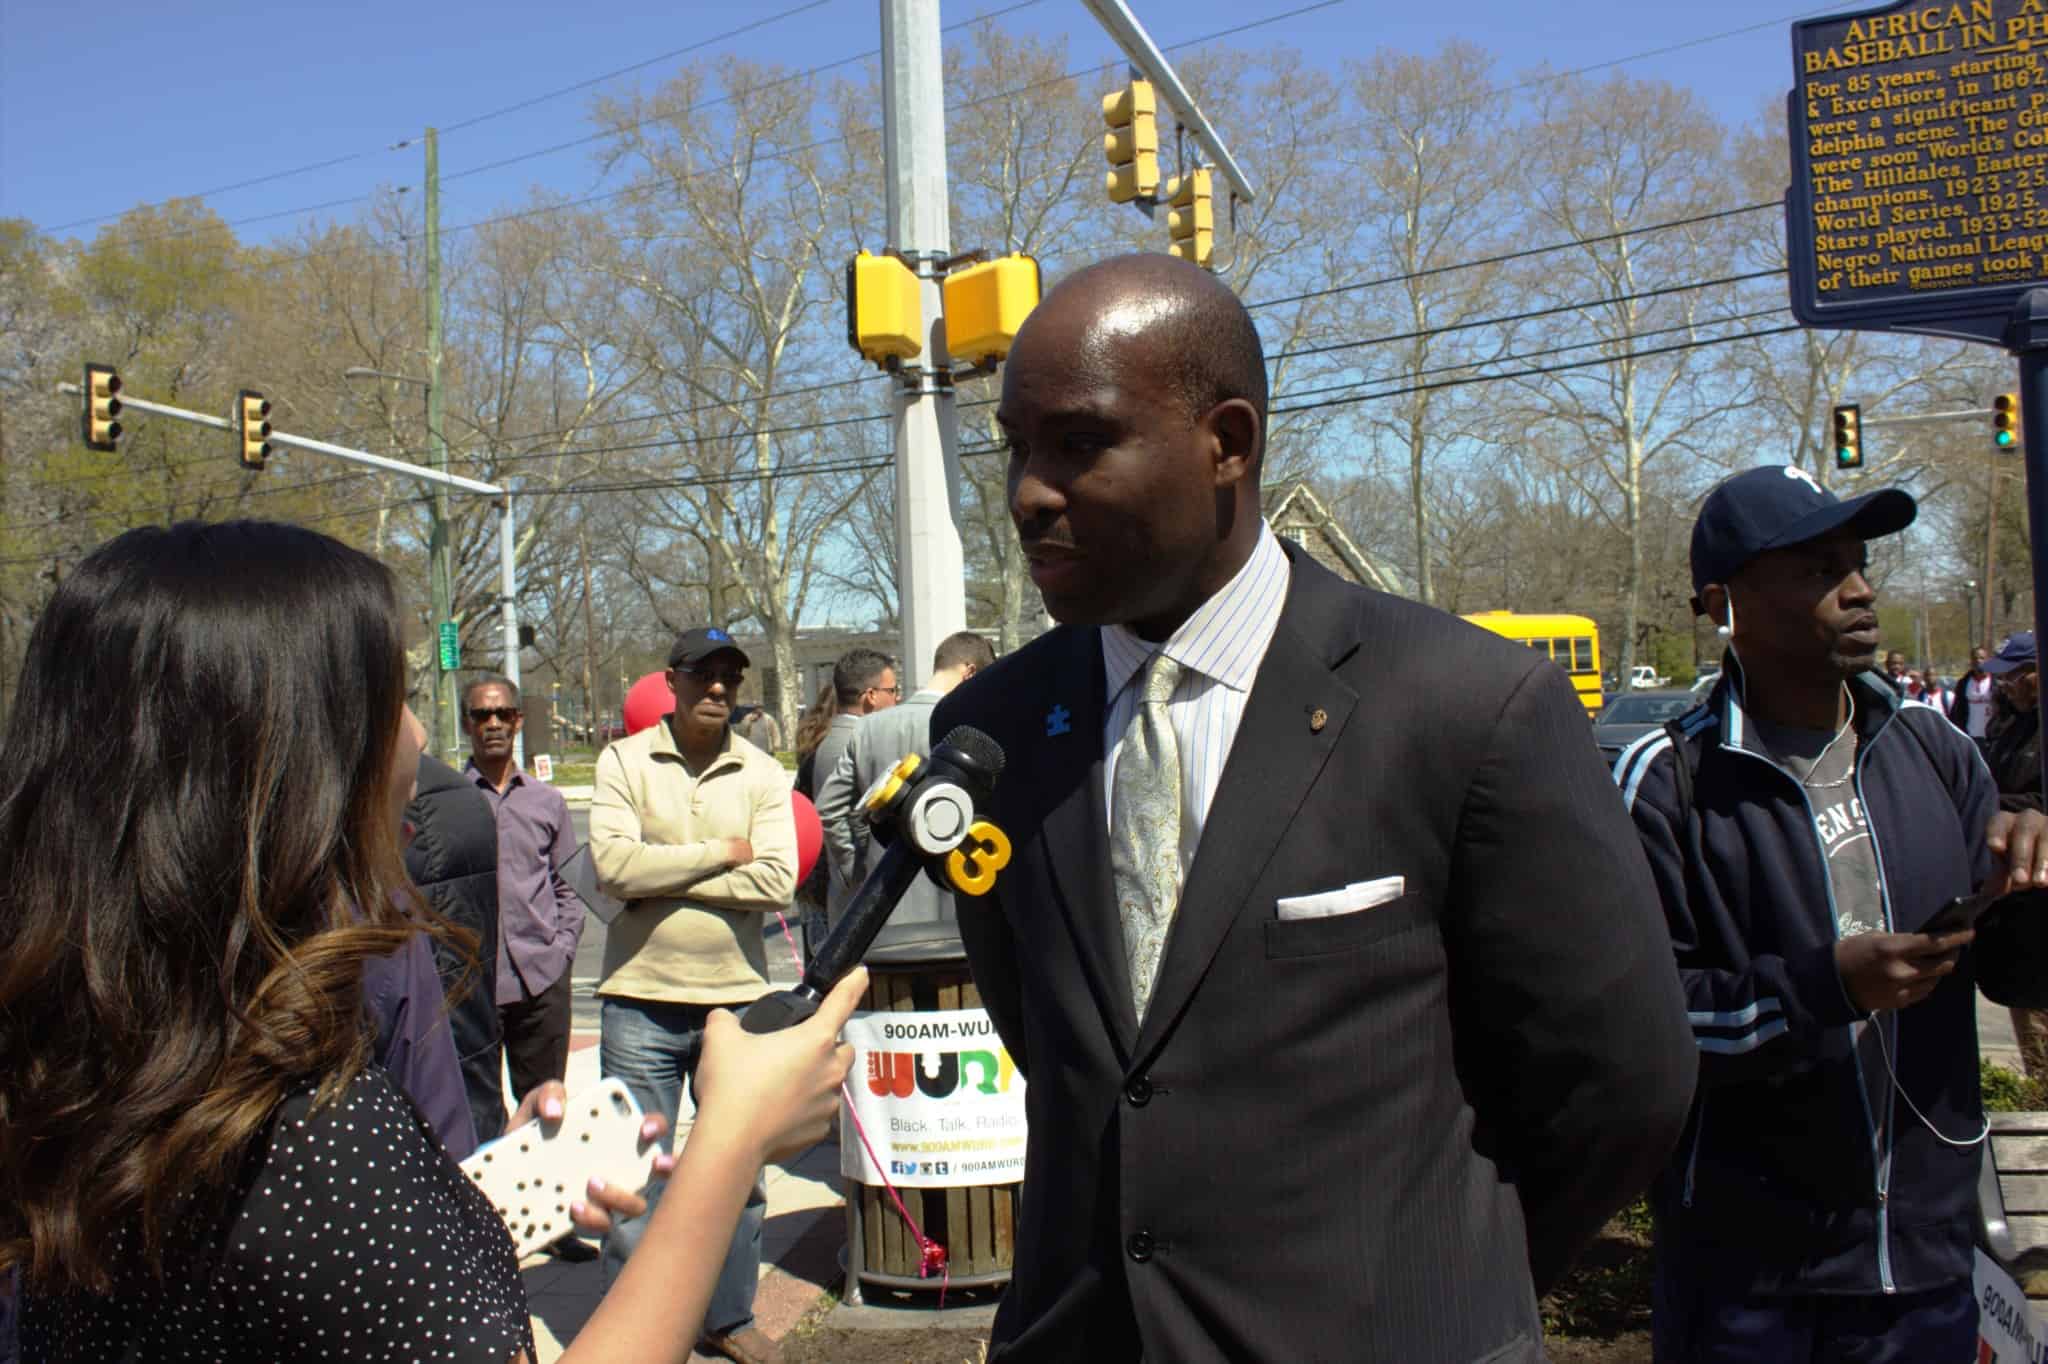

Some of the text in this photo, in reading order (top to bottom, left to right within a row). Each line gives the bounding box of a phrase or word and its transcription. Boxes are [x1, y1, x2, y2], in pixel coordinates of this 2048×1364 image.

[1843, 0, 1993, 43] AFRICAN
[1804, 31, 1954, 73] BASEBALL
[1961, 21, 1997, 48] IN
[1806, 80, 1840, 100] For
[1847, 73, 1871, 92] 85
[1951, 53, 2037, 78] starting
[1807, 101, 1820, 118] &
[1831, 87, 1946, 116] Excelsiors
[1958, 79, 1979, 96] in
[1808, 119, 1857, 137] were
[1870, 115, 1882, 129] a
[1893, 94, 2016, 127] significant
[1810, 132, 1886, 157] delphia
[1963, 114, 2008, 135] The
[1811, 156, 1862, 176] were
[1870, 150, 1918, 169] soon
[1812, 175, 1854, 195] The
[1816, 208, 1880, 232] World
[1815, 234, 1869, 252] Stars
[1817, 252, 1880, 273] Negro
[1890, 236, 1981, 264] National
[1818, 271, 1842, 291] of
[1849, 267, 1900, 288] their
[1908, 262, 1974, 284] games
[1982, 250, 2032, 273] took
